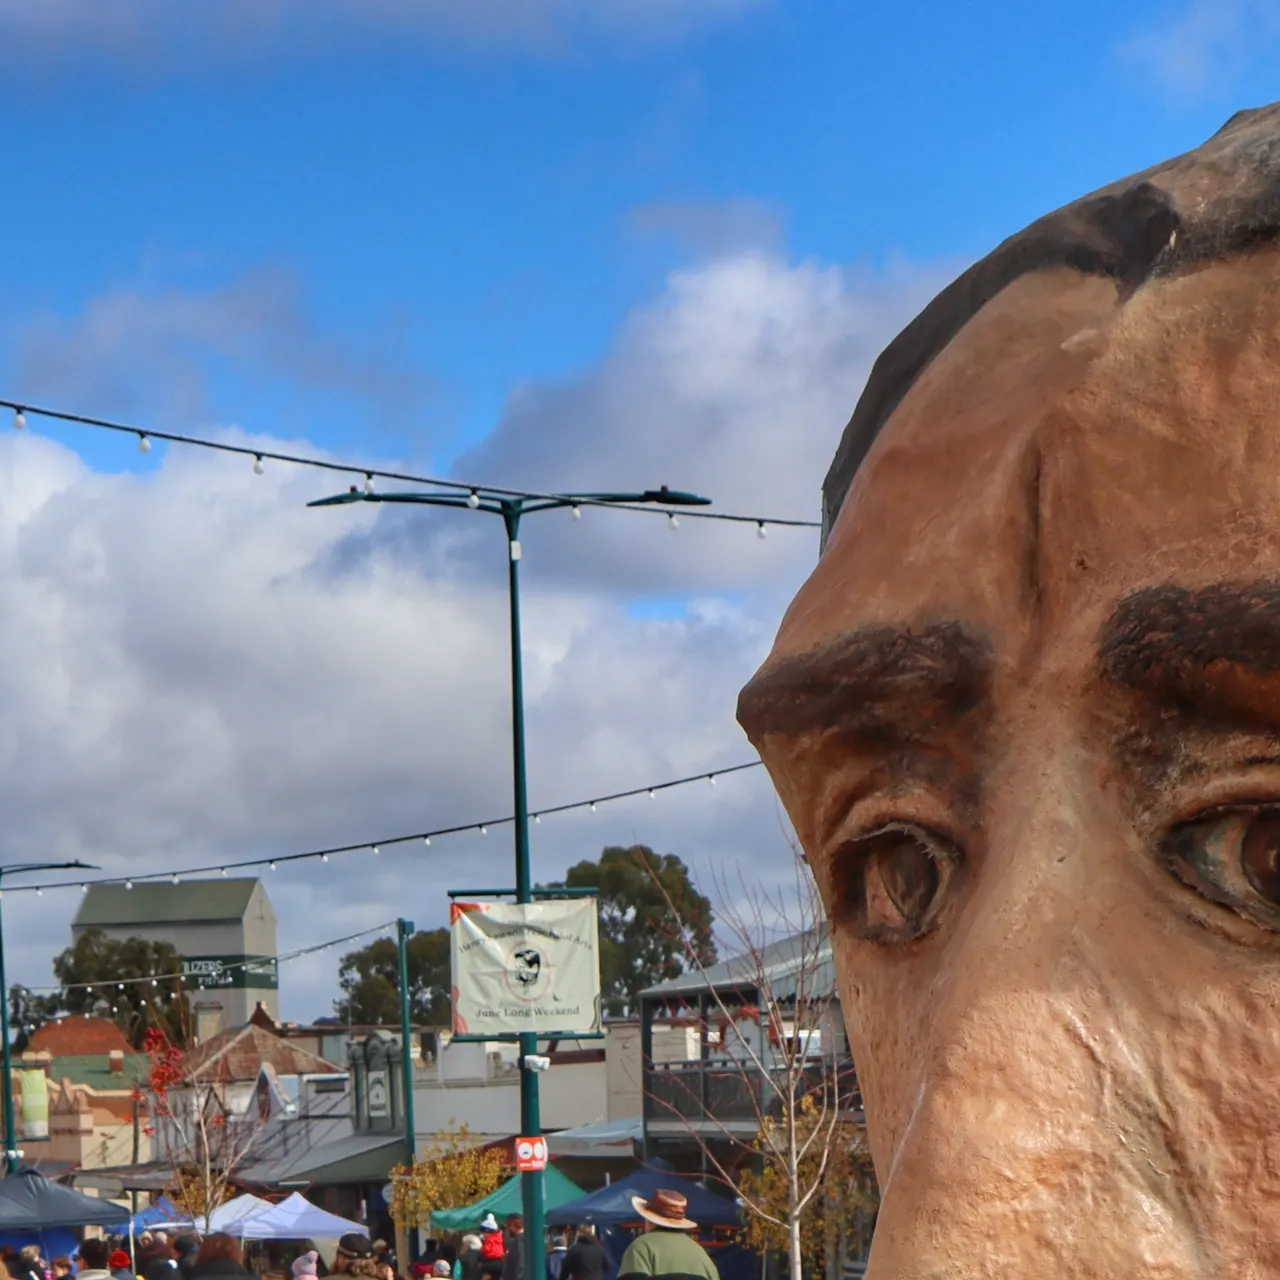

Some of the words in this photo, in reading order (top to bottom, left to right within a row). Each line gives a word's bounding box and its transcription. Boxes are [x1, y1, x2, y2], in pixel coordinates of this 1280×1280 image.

[573, 936, 593, 951] Arts
[475, 1007, 500, 1018] June
[504, 1006, 532, 1018] Long
[534, 1005, 580, 1017] Weekend
